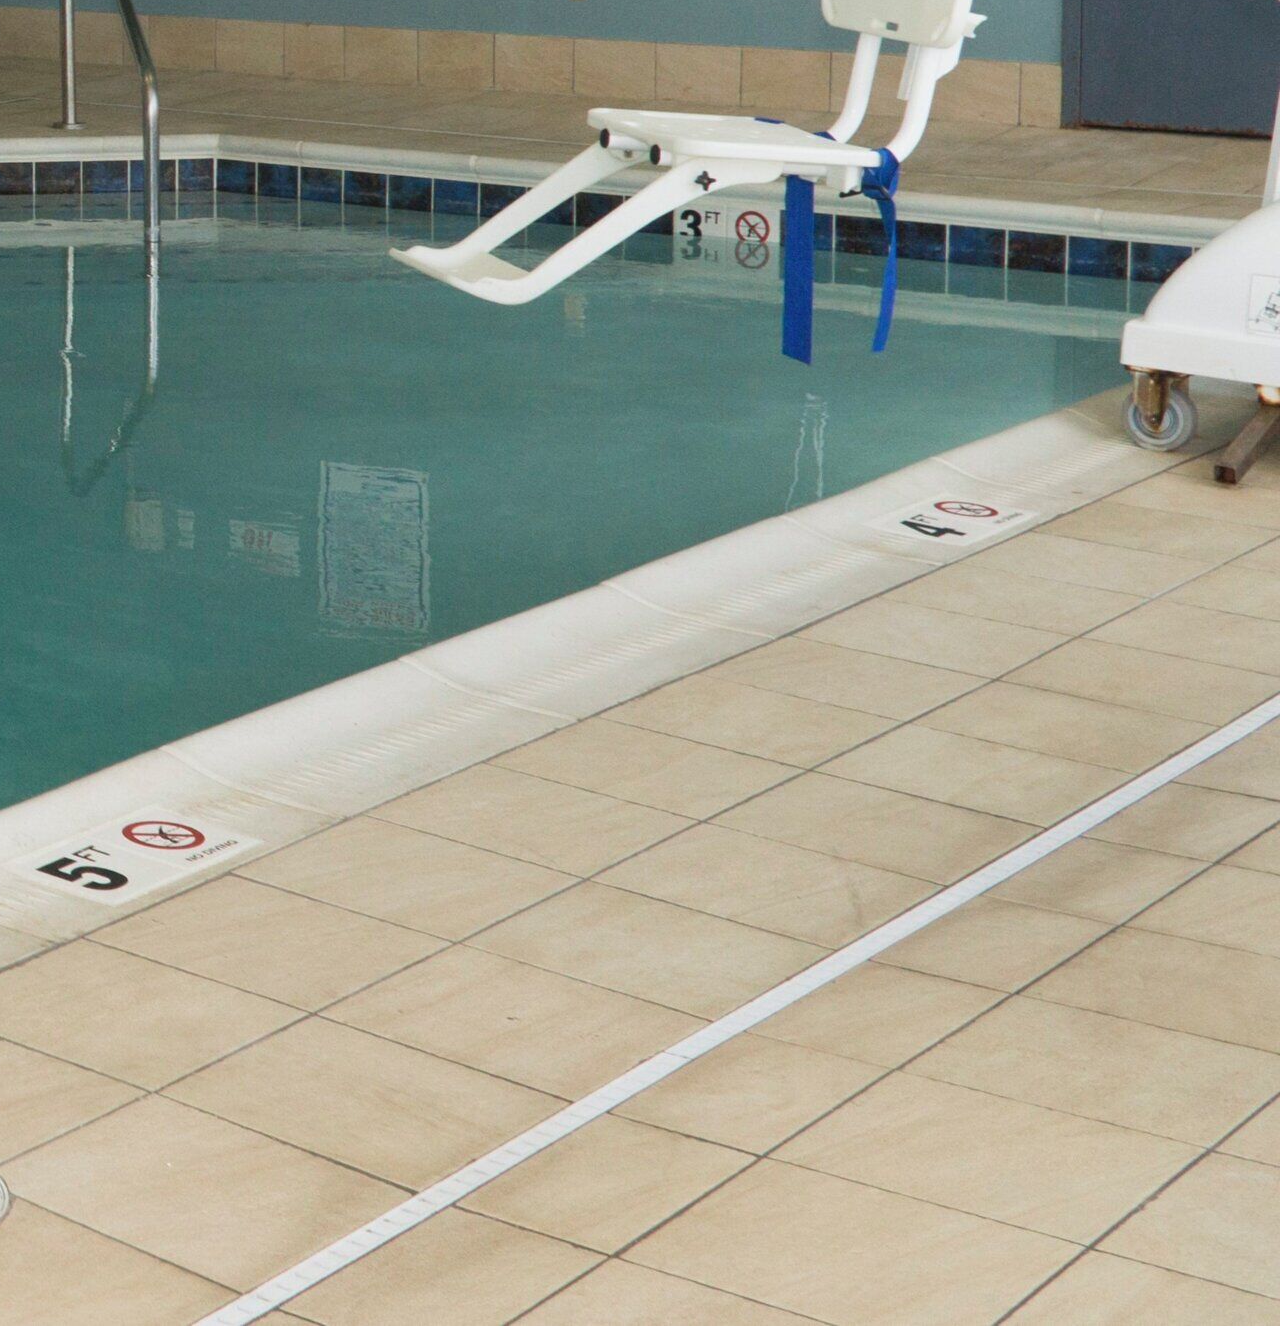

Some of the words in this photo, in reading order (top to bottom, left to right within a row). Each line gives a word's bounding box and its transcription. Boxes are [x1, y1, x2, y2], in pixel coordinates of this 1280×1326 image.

[679, 209, 702, 237] 3
[704, 211, 721, 225] FT
[901, 519, 966, 538] 4
[910, 513, 938, 524] FT
[71, 844, 111, 863] FT
[185, 852, 203, 862] NO
[202, 839, 239, 858] DIVING
[35, 855, 129, 891] 5
